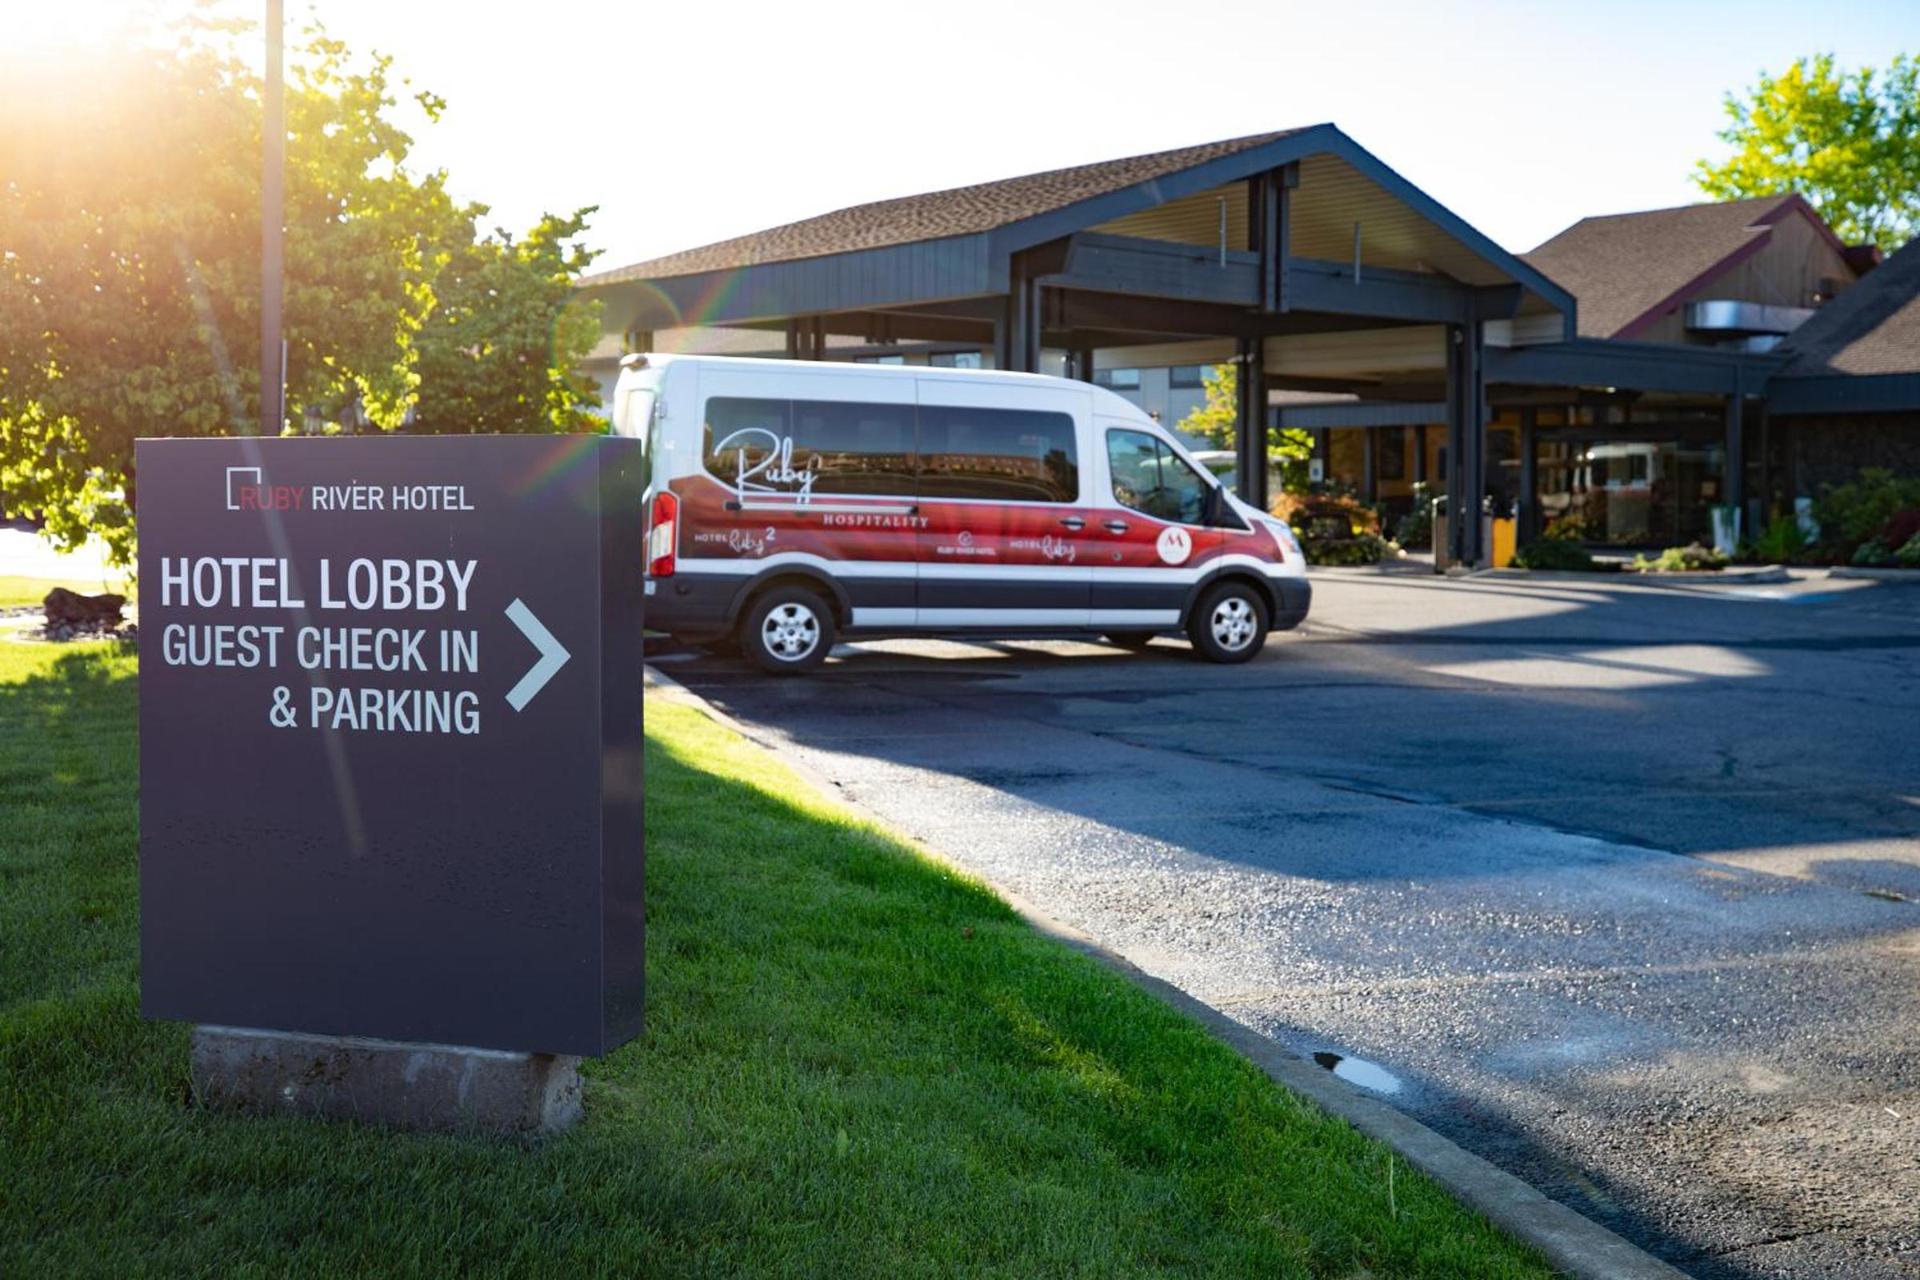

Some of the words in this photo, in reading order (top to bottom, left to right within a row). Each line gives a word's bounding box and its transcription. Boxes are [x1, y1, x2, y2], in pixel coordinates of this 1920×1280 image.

[713, 427, 819, 504] Ruby
[240, 486, 305, 511] RUBY
[312, 485, 384, 511] RIVER
[392, 485, 475, 511] HOTEL
[823, 514, 929, 527] HOSPITALITY
[694, 533, 728, 542] HOTEL
[765, 526, 776, 541] 2
[161, 557, 305, 608] HOTEL
[320, 558, 478, 612] LOBBY
[163, 624, 284, 668] GUEST
[296, 626, 427, 673] CHECK
[440, 629, 479, 673] IN
[269, 686, 298, 728] &
[311, 688, 480, 734] PARKING
